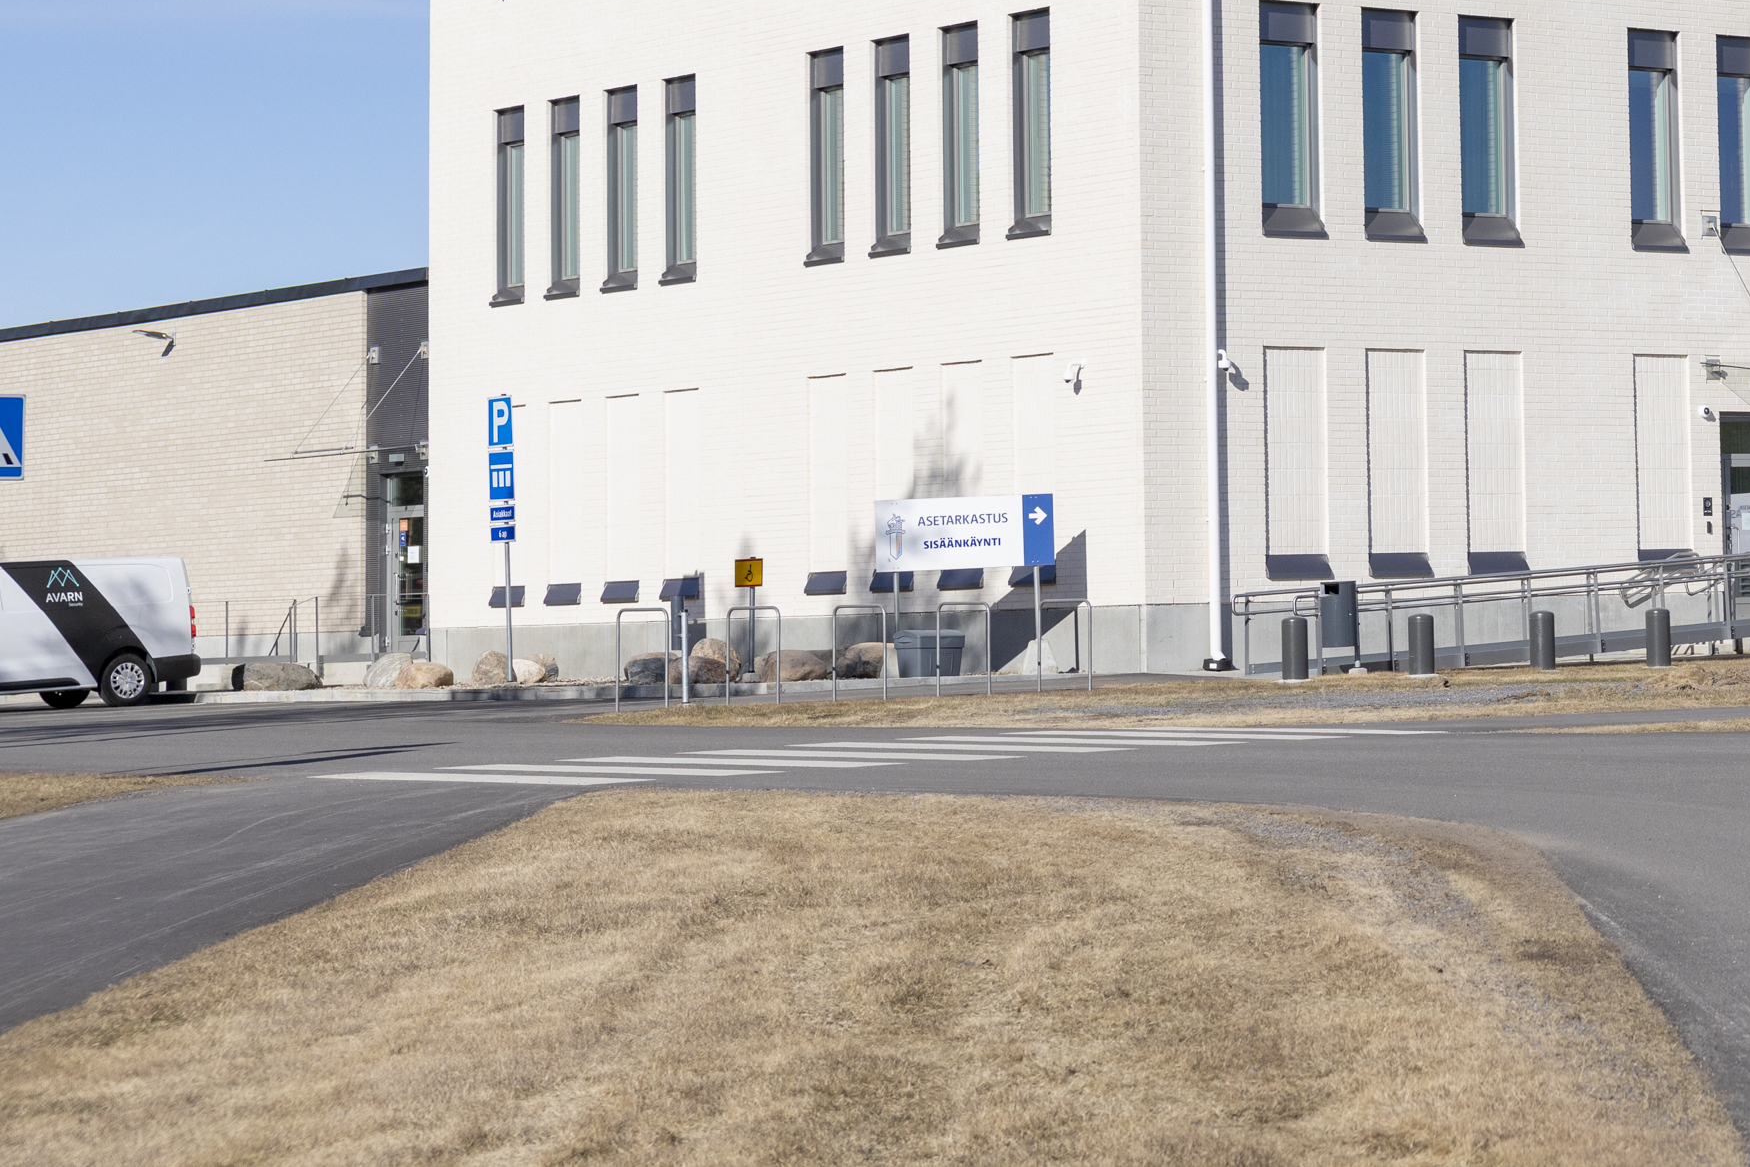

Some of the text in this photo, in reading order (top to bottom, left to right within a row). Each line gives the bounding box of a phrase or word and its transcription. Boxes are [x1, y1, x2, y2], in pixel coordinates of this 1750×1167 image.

[492, 400, 509, 443] P
[917, 512, 1009, 527] ASETARKASTUS
[923, 536, 1001, 549] SISÄÄNKÄYNTI
[45, 591, 83, 603] AVARN
